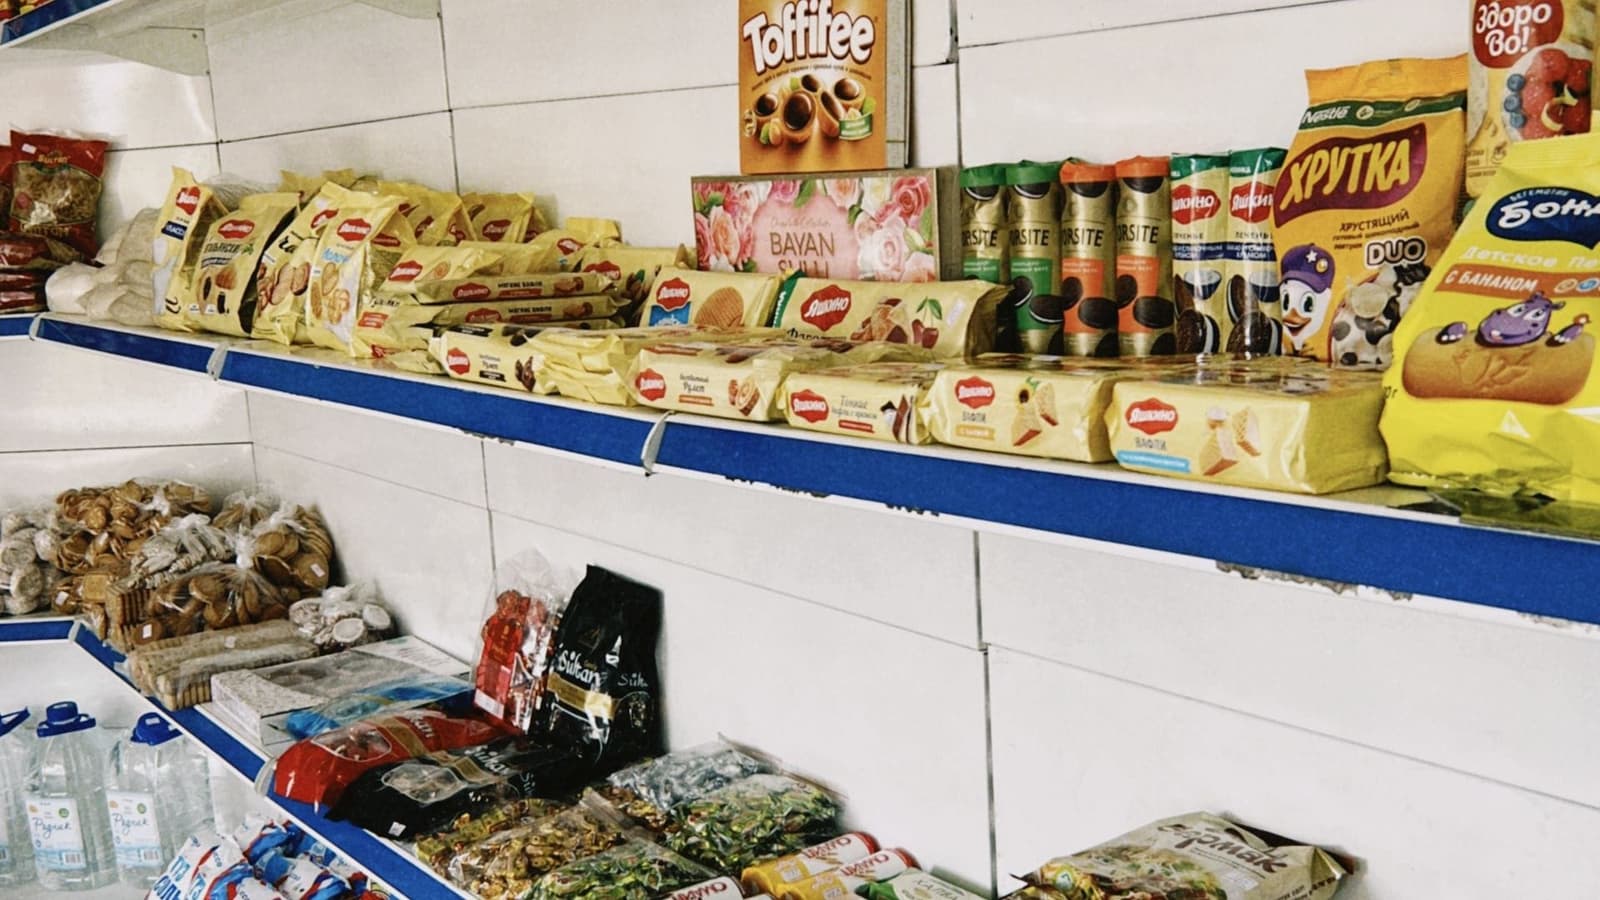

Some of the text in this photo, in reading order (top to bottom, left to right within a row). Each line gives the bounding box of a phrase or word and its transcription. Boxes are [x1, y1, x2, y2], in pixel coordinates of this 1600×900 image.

[743, 0, 875, 75] Toffifee
[1485, 28, 1530, 56] Во!
[1279, 138, 1411, 211] ХРУТКА
[769, 231, 835, 257] BAYAN
[1366, 238, 1426, 267] DUO
[1459, 270, 1538, 292] БАНАНОМ
[804, 297, 849, 318] Яшкино
